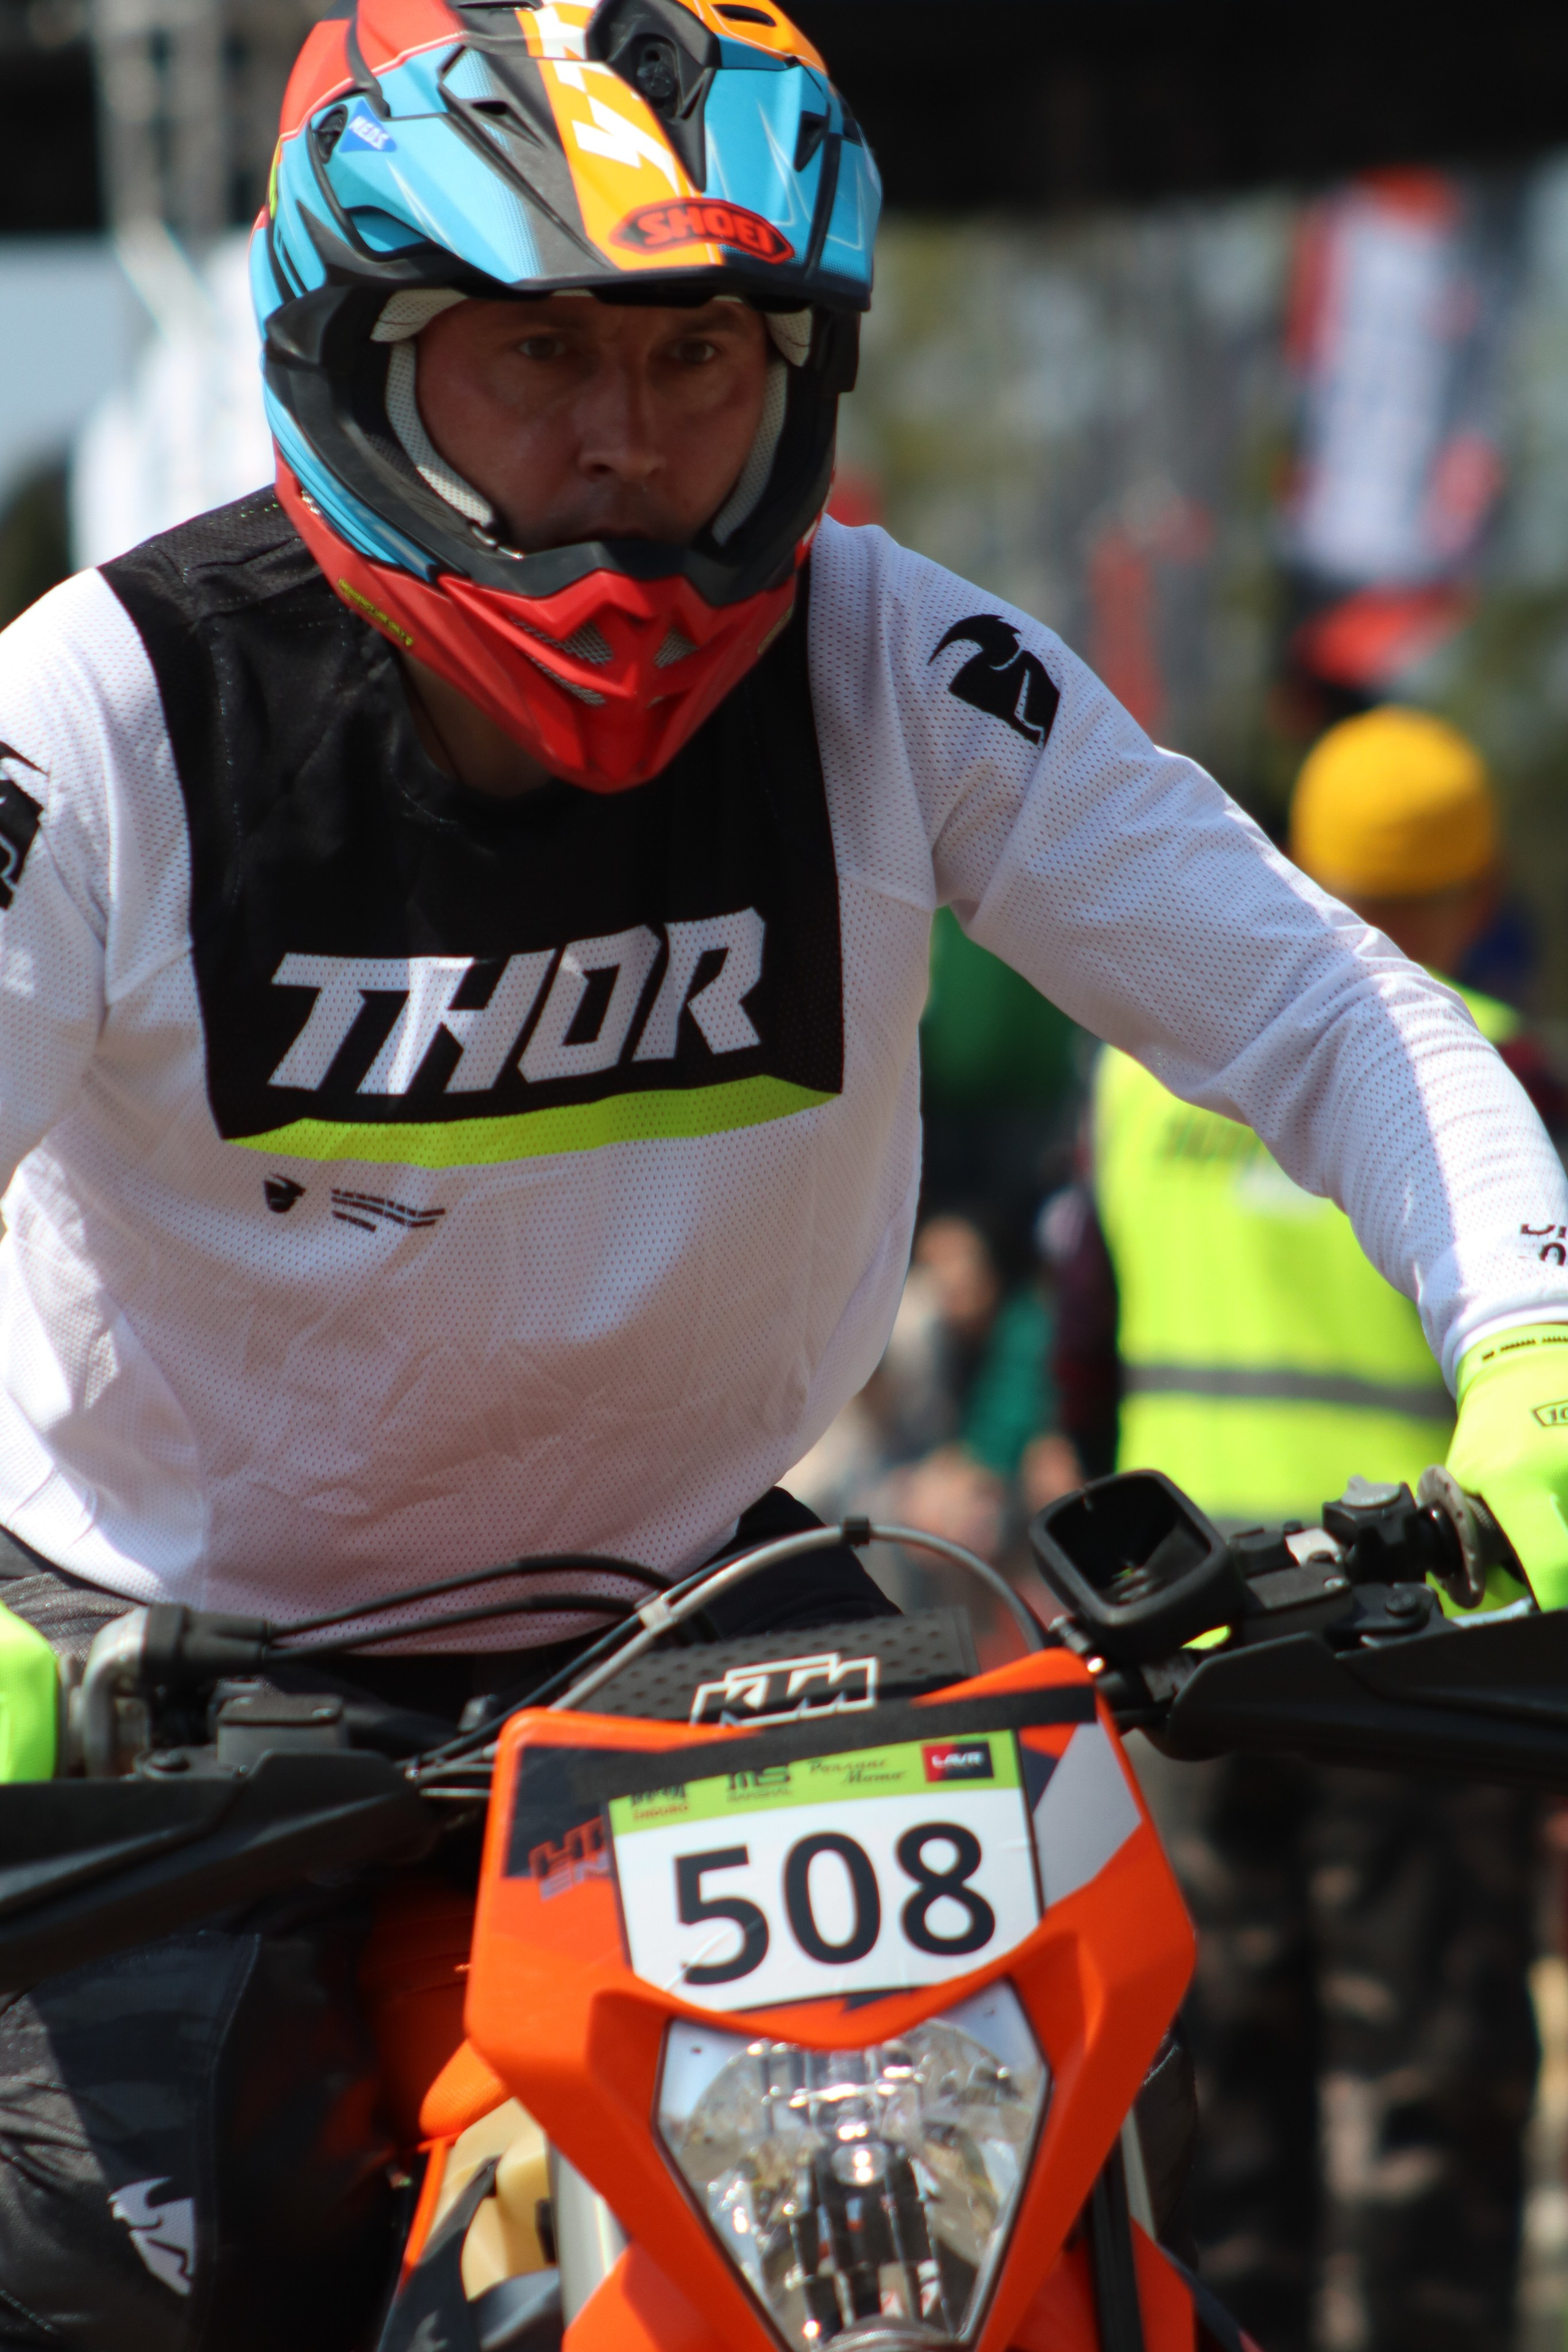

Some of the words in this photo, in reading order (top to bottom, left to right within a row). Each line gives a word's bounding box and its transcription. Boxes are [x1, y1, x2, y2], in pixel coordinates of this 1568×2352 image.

[636, 206, 774, 254] SHOEI
[267, 906, 766, 1095] THOR
[690, 1651, 878, 1727] KTM
[674, 1821, 996, 1986] 508
